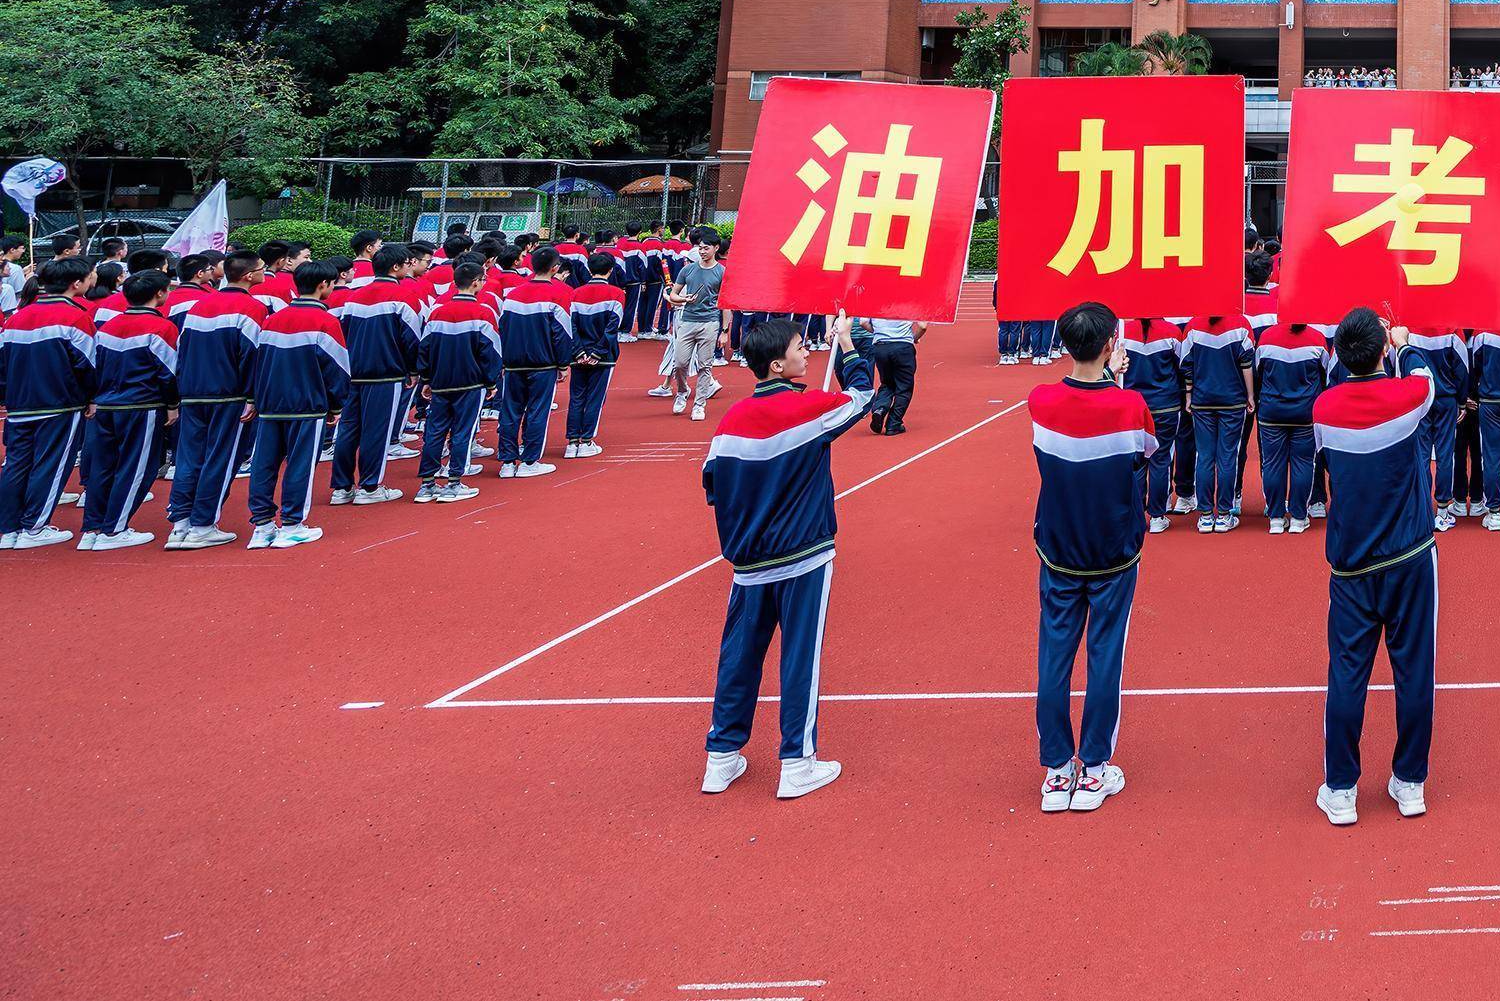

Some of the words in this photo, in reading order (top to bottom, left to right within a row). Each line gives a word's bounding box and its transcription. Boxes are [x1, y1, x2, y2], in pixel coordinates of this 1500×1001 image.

[780, 123, 943, 277] 油
[1048, 118, 1204, 276] 加
[1325, 128, 1486, 286] 考
